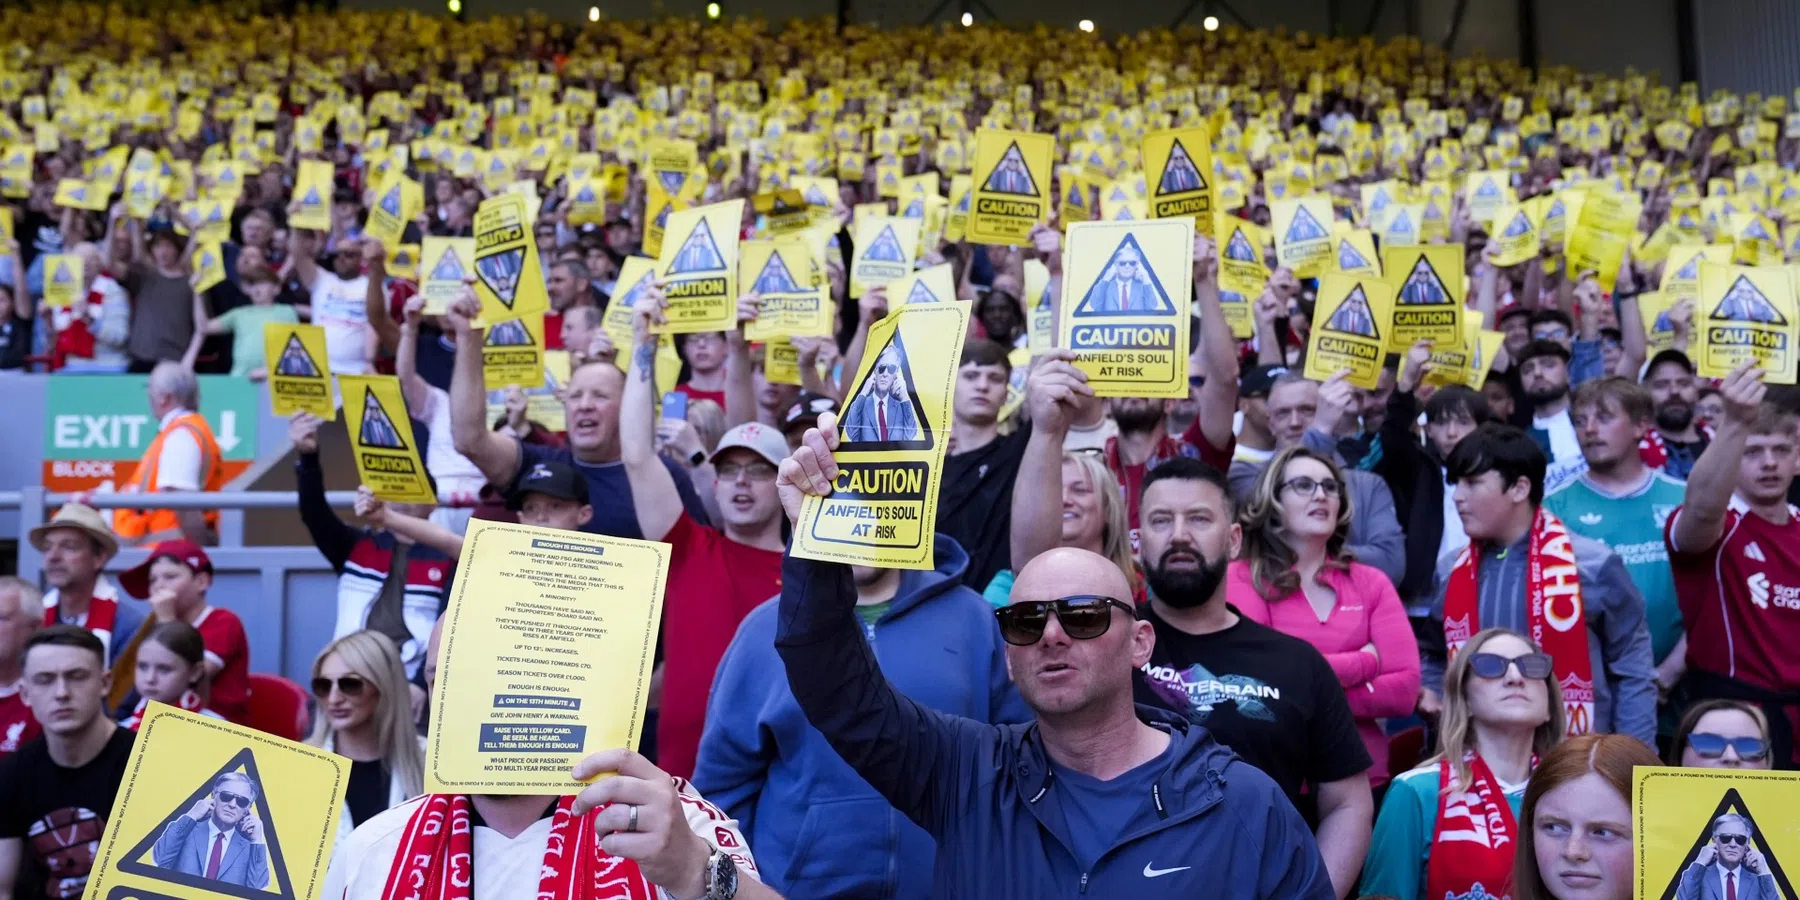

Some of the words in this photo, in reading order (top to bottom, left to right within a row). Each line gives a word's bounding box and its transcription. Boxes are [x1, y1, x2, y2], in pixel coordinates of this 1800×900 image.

[980, 200, 1038, 217] CAUTION
[1159, 198, 1208, 215] CAUTION
[1395, 312, 1453, 325] CAUTION
[1075, 328, 1170, 346] CAUTION
[1711, 329, 1783, 348] CAUTION
[1320, 338, 1376, 359] CAUTION
[1075, 353, 1134, 363] ANFIELD'S
[1137, 354, 1169, 364] SOUL
[1098, 366, 1114, 376] AT
[1116, 367, 1144, 377] RISK
[54, 414, 148, 448] EXIT
[53, 461, 116, 477] BLOCK
[366, 455, 412, 472] CAUTION
[833, 468, 922, 494] CAUTION
[825, 504, 891, 520] ANFIELD'S
[892, 507, 918, 520] SOUL
[851, 524, 872, 536] AT
[875, 525, 896, 539] RISK
[514, 602, 551, 610] THOUSANDS
[1141, 662, 1280, 700] MONTERRAIN
